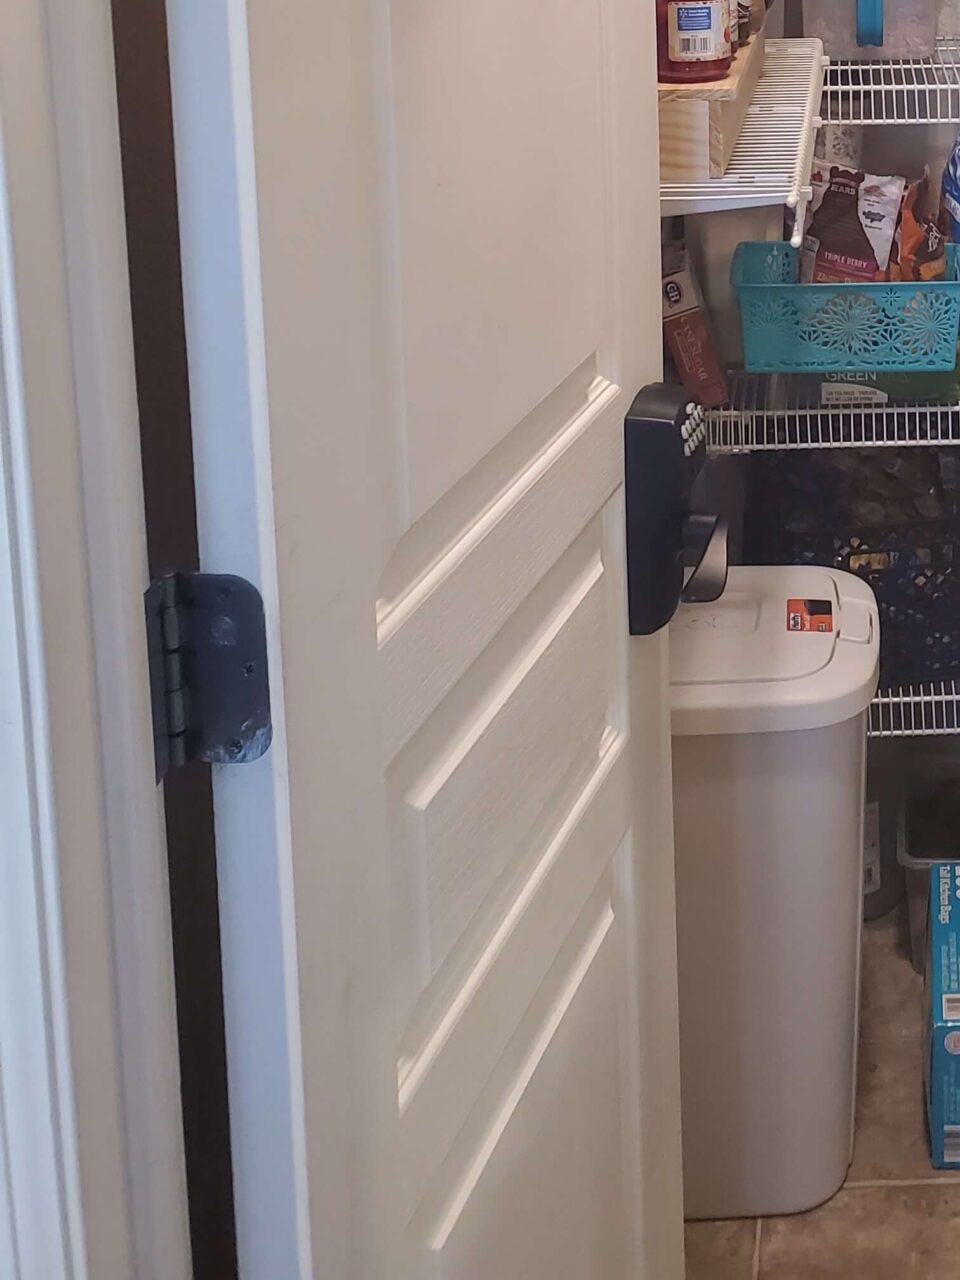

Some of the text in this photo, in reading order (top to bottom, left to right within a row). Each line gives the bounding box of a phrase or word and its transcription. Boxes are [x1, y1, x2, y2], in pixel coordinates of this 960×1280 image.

[824, 251, 868, 269] TRIPLE BERRY
[825, 371, 877, 381] GREEN
[938, 865, 951, 924] Tall Kitchen Bags
